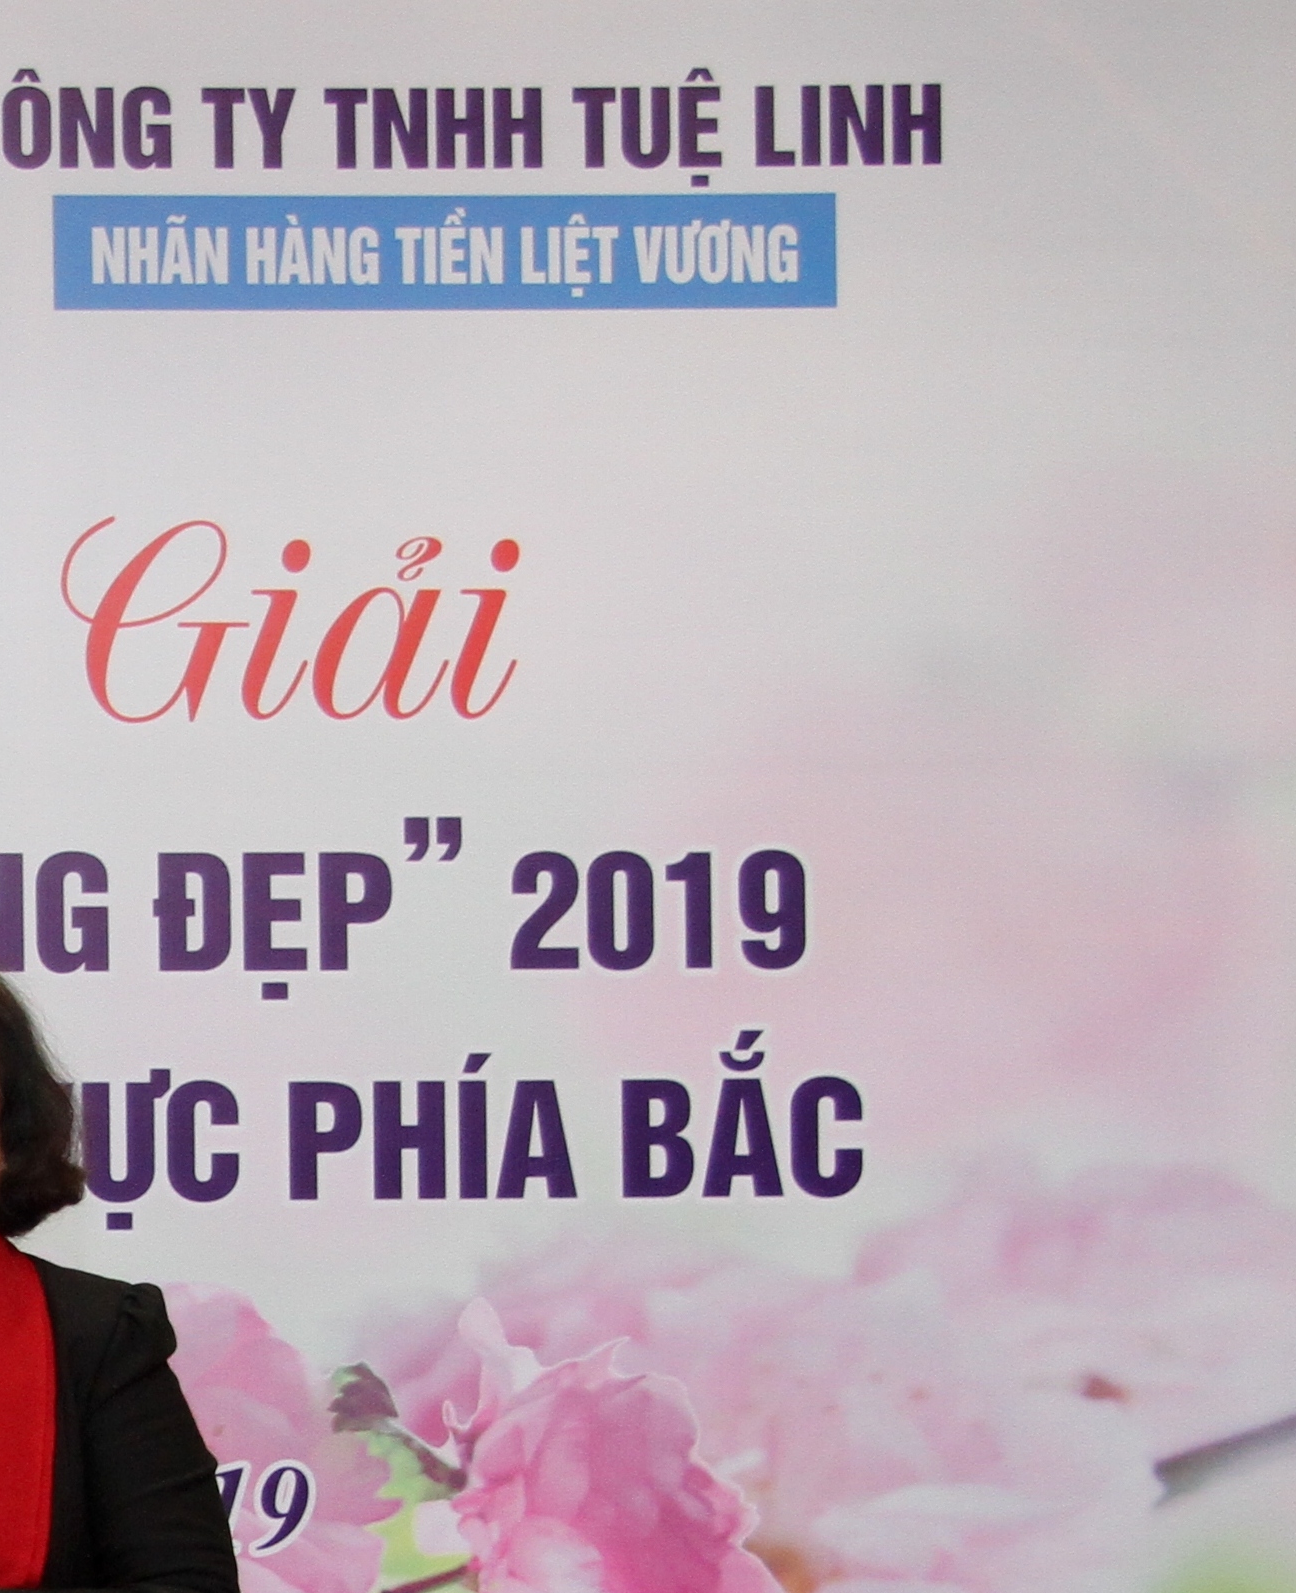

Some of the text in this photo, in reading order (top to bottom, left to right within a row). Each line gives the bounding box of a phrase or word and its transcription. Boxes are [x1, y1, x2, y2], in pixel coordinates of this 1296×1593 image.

[201, 87, 295, 169] TY
[323, 86, 543, 169] TNHH
[572, 67, 722, 187] TUỆ
[755, 83, 942, 167] LINH
[91, 207, 800, 298] NHÃN HÀNG TIỀN LIỆT VƯƠNG
[59, 515, 523, 724] Giải
[510, 849, 807, 972] 2019
[62, 1028, 864, 1231] ỰC PHÍA BẮC
[215, 1466, 310, 1550] 19
